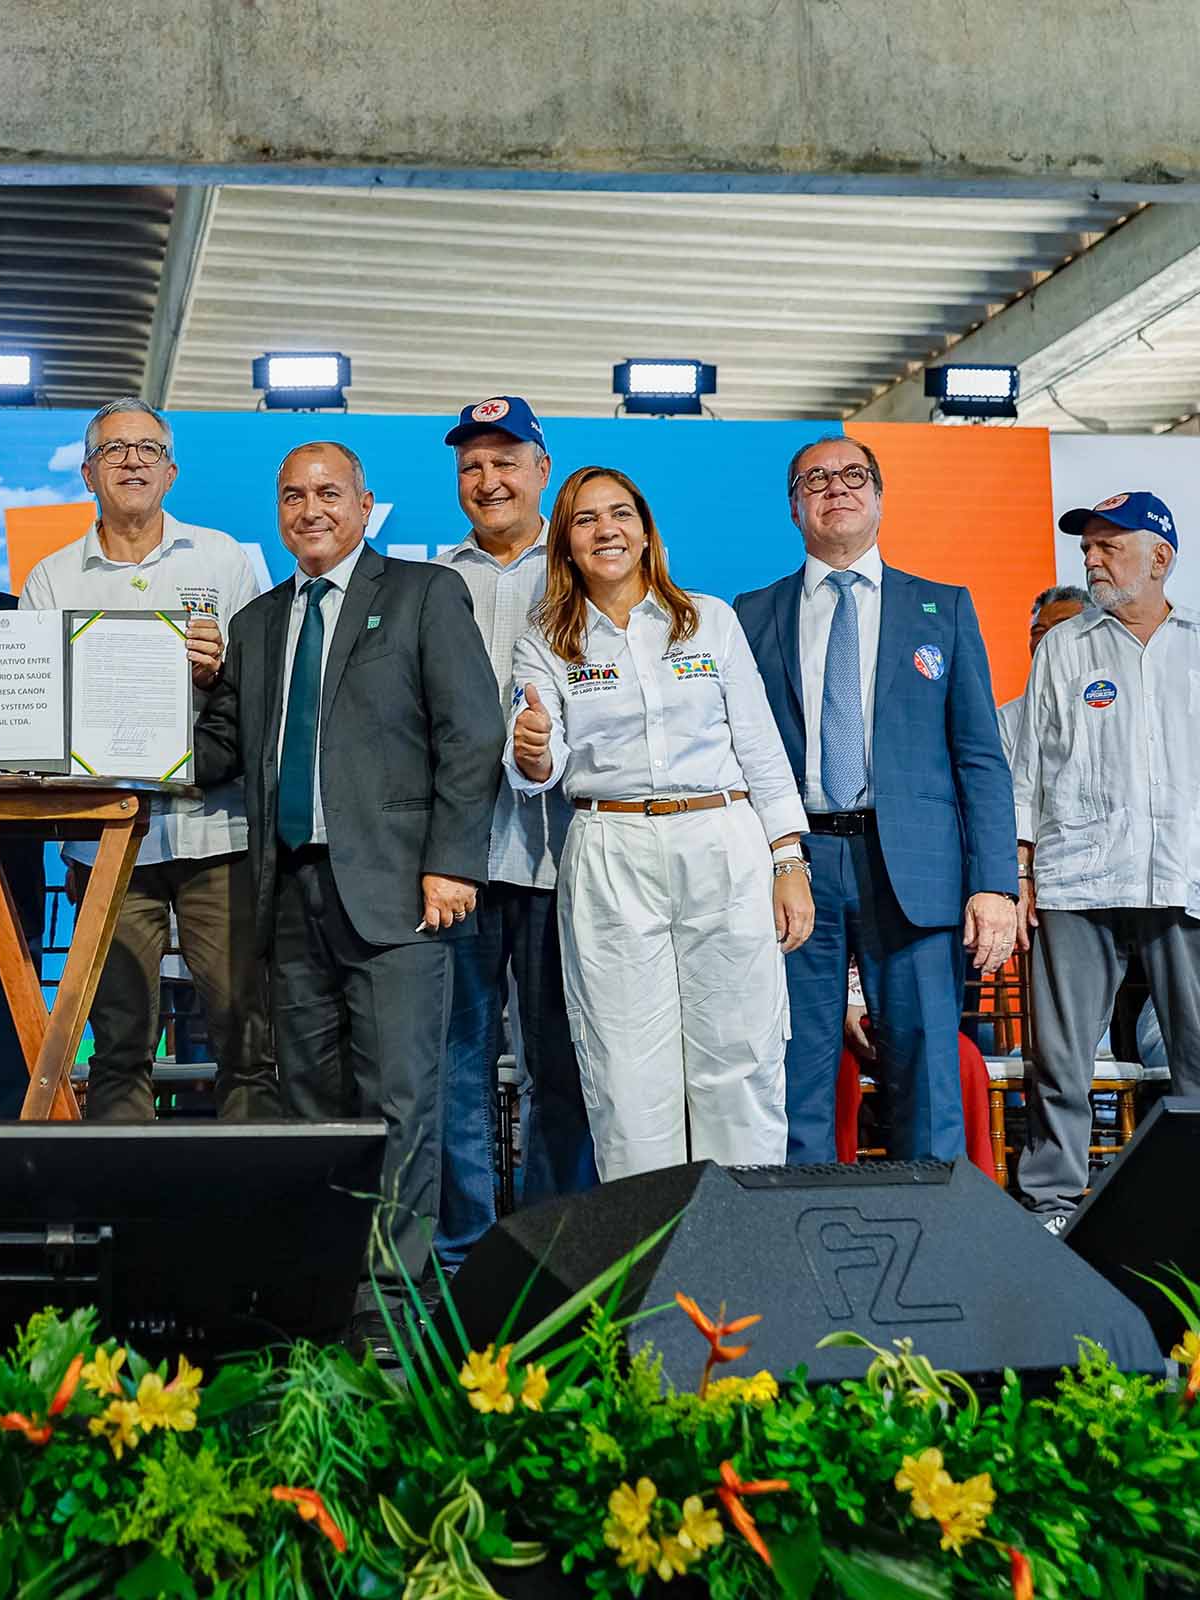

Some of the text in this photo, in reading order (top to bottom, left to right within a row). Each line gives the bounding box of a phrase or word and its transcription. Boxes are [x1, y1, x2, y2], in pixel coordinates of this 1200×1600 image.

[672, 659, 719, 677] BRASIL
[26, 671, 51, 679] SAÚDE
[568, 669, 619, 685] BAHIA
[0, 703, 35, 711] SYSTEMS
[10, 718, 32, 726] LTDA.
